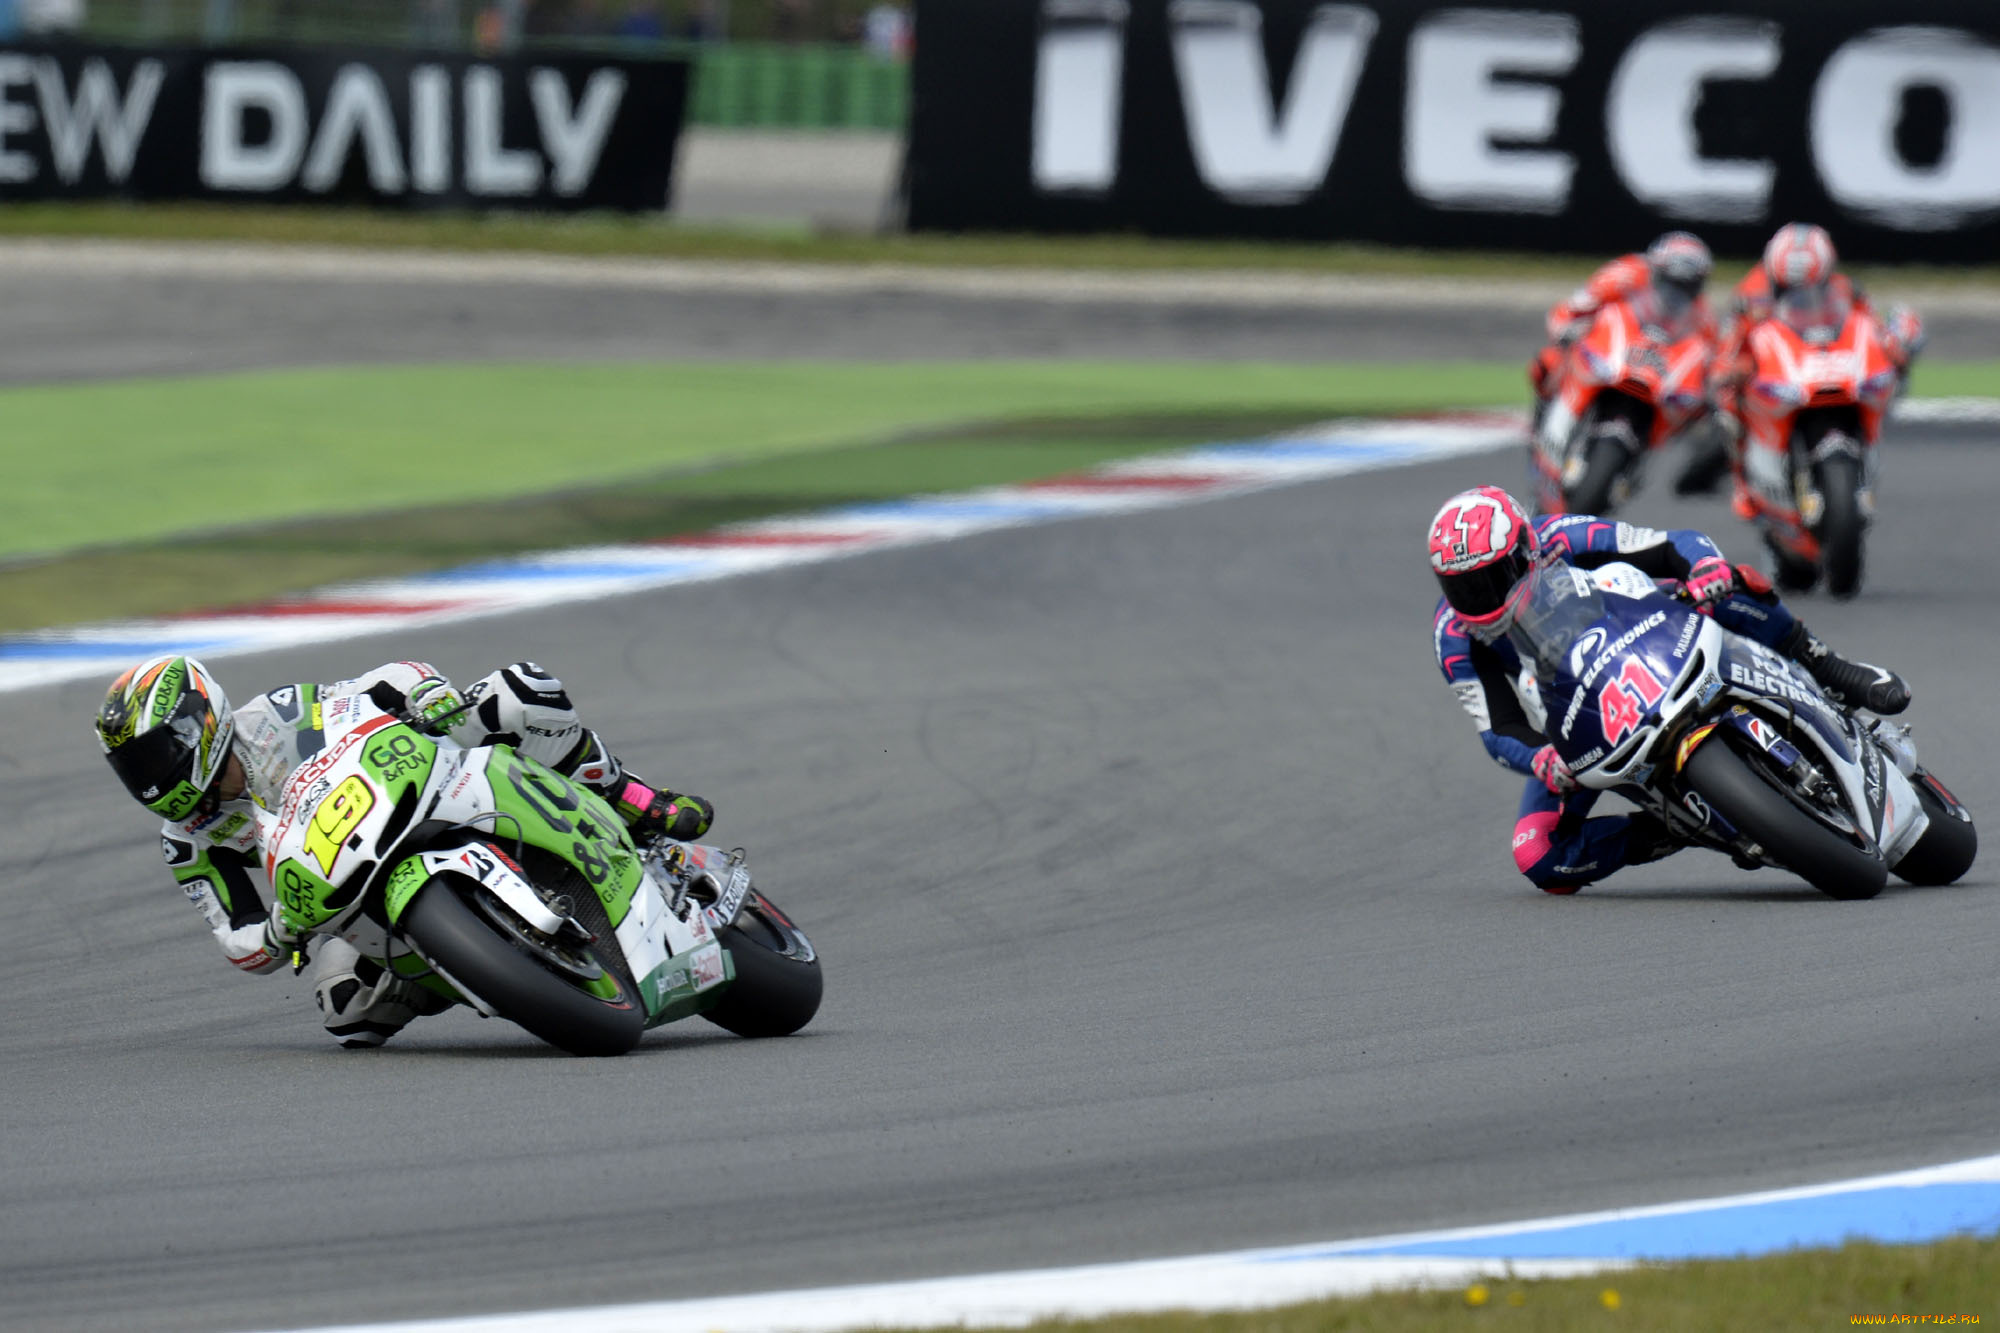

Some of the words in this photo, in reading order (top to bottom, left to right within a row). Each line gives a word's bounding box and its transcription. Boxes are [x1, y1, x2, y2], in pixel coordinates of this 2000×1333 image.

[201, 60, 628, 196] DAILY
[1030, 4, 2000, 232] IVECO
[1561, 684, 1586, 740] POWER
[1583, 610, 1666, 689] ELECTRONICS
[1598, 653, 1667, 748] 41
[369, 735, 416, 768] GO
[382, 752, 428, 782] &FUN
[303, 774, 376, 880] 19
